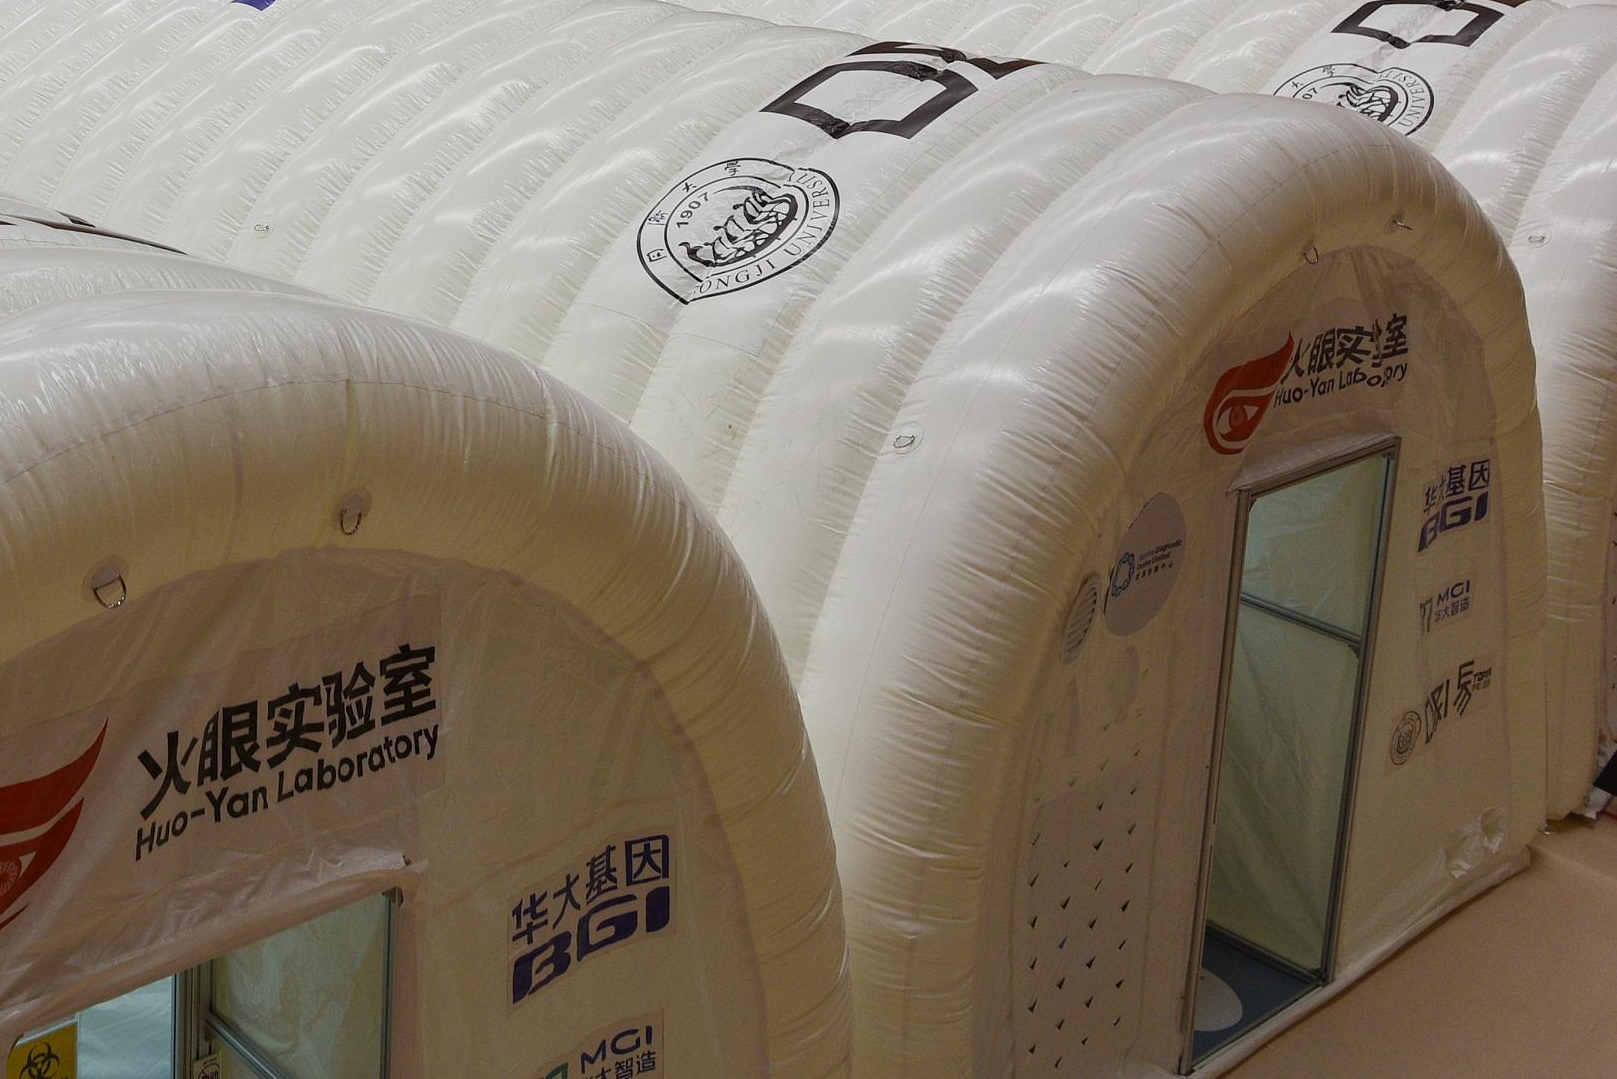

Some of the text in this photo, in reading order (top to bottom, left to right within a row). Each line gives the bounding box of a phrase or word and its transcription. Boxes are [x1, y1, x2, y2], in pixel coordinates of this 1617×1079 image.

[676, 191, 710, 230] 1907
[1273, 374, 1335, 409] Huo-Yan
[1423, 458, 1491, 515] 华大基因
[1418, 491, 1489, 553] BGI
[1437, 579, 1471, 606] MGI
[137, 643, 437, 820] 火眼实验室
[135, 724, 439, 862] Huo-Yan Laboratory
[512, 834, 670, 945] 华大基因
[512, 885, 671, 1004] BGI
[580, 1025, 653, 1074] MGI
